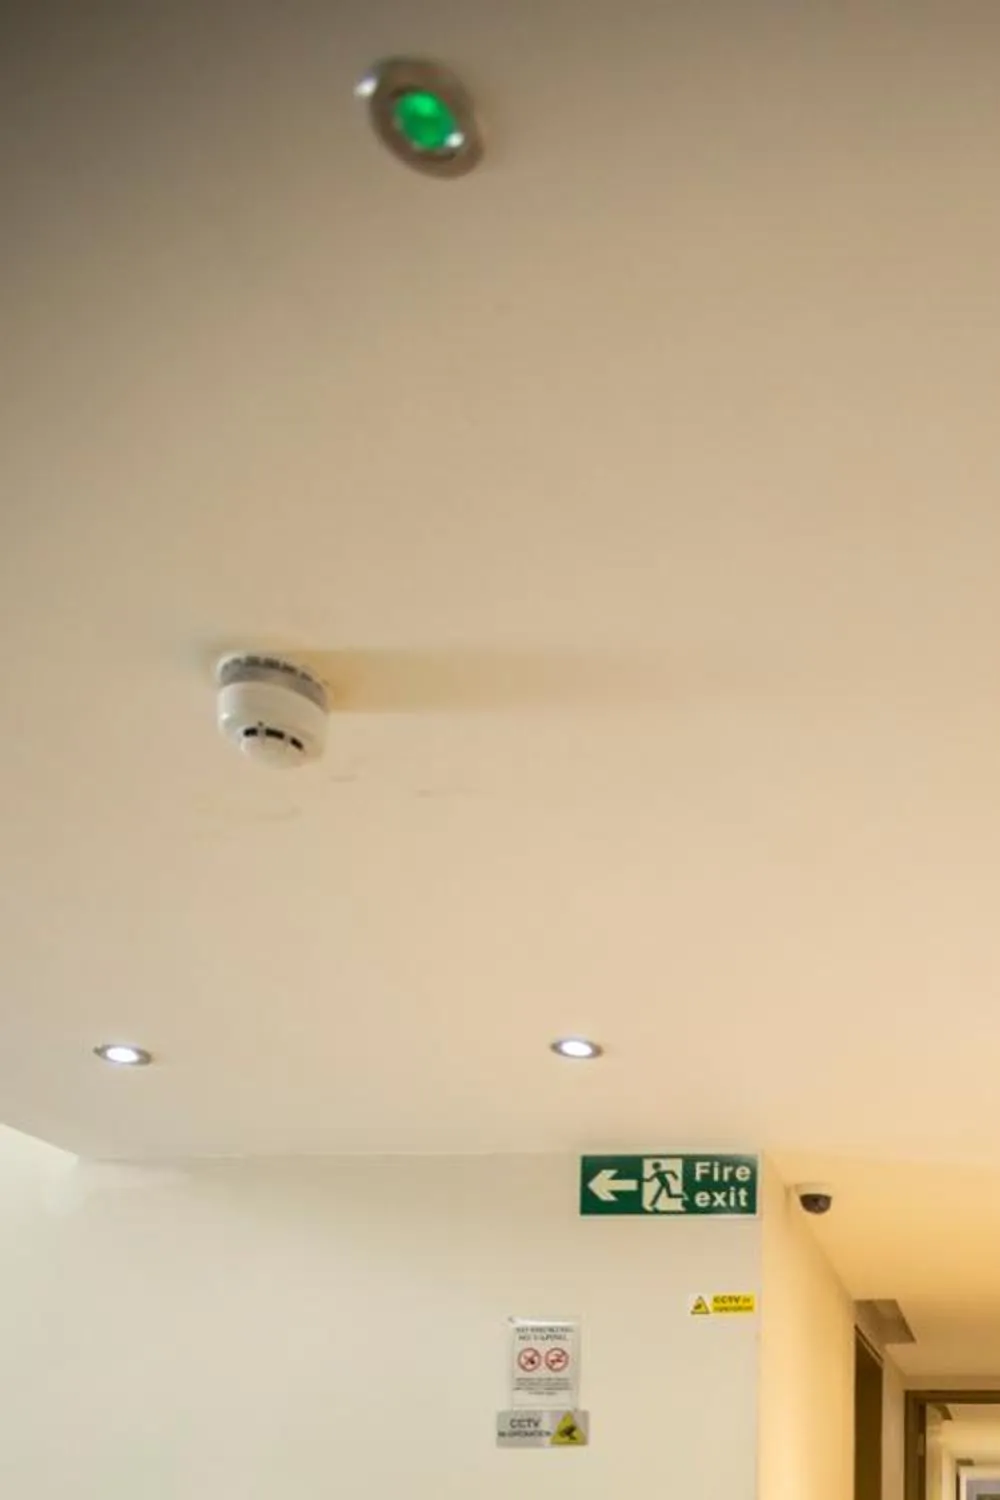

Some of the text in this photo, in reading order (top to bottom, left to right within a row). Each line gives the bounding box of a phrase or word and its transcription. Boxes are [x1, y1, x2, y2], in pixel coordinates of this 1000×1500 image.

[694, 1161, 751, 1182] Fire
[694, 1186, 748, 1207] exit
[712, 1295, 741, 1304] CCTV
[509, 1417, 540, 1429] CCTV
